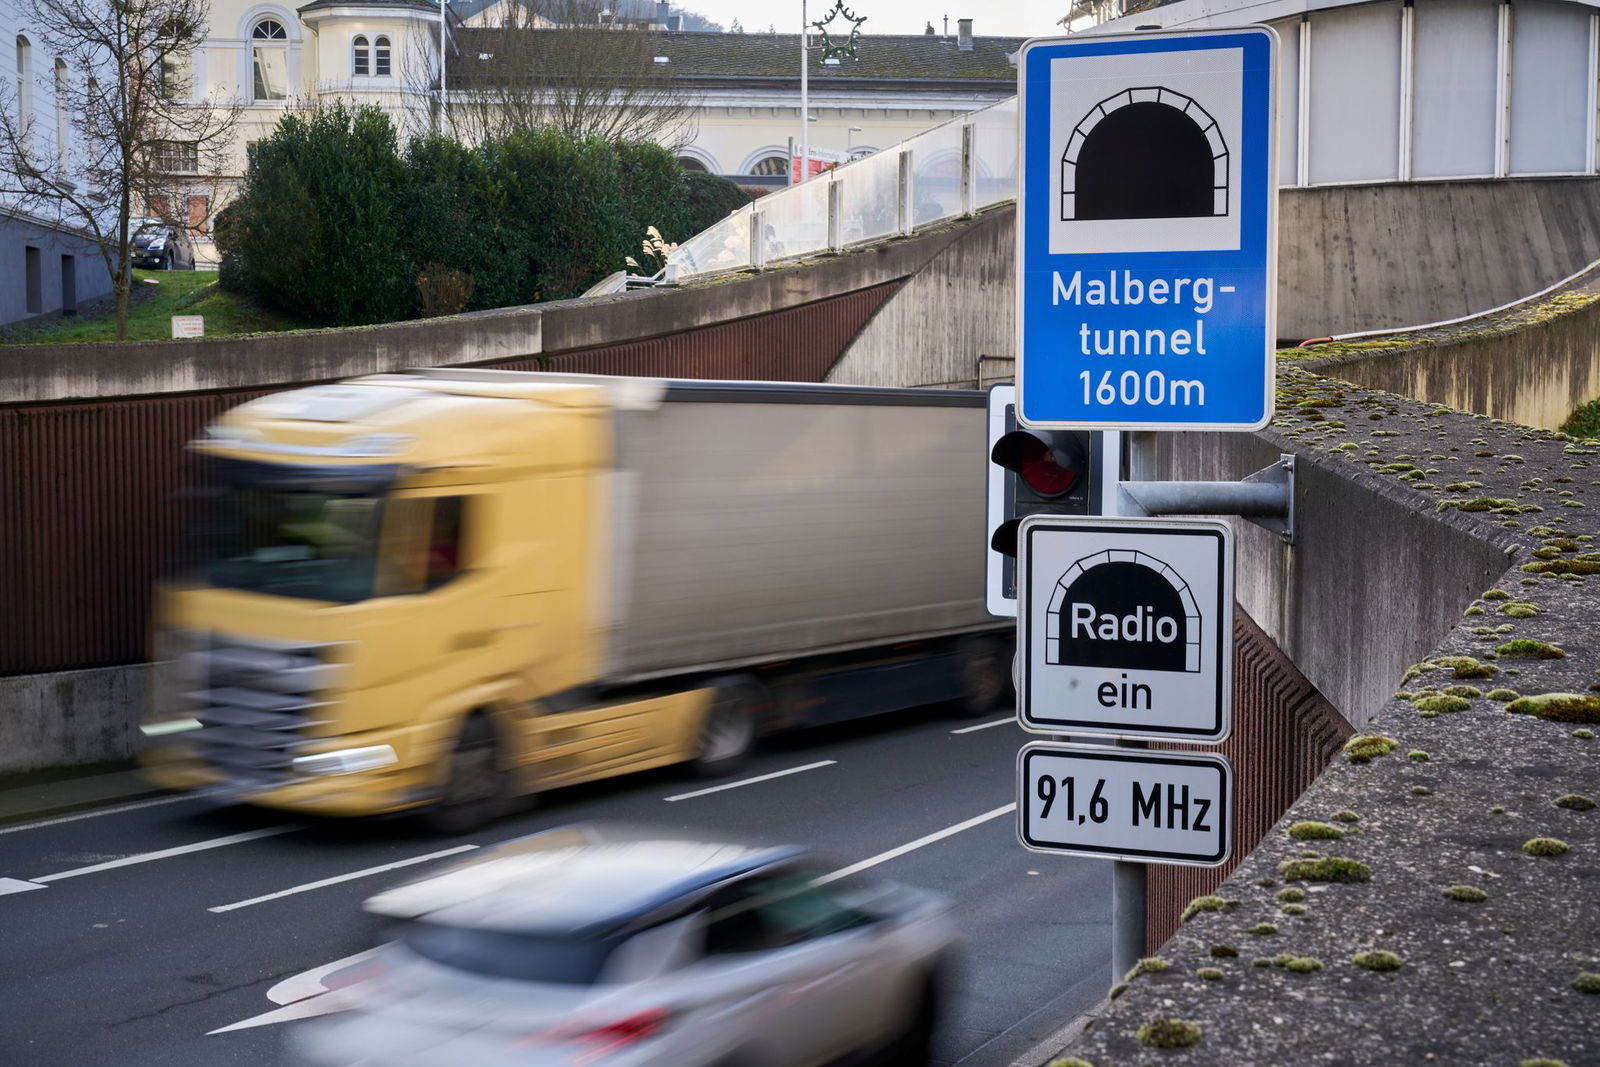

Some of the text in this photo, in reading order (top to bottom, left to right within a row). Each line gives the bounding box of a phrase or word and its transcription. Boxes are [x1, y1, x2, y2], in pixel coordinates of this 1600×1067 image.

[1053, 270, 1236, 313] Malberg-
[1079, 320, 1207, 356] tunnel
[1079, 370, 1205, 406] 1600m
[1071, 602, 1179, 644] Radio
[1097, 673, 1153, 710] ein
[1037, 774, 1212, 832] 91,6 MHz
